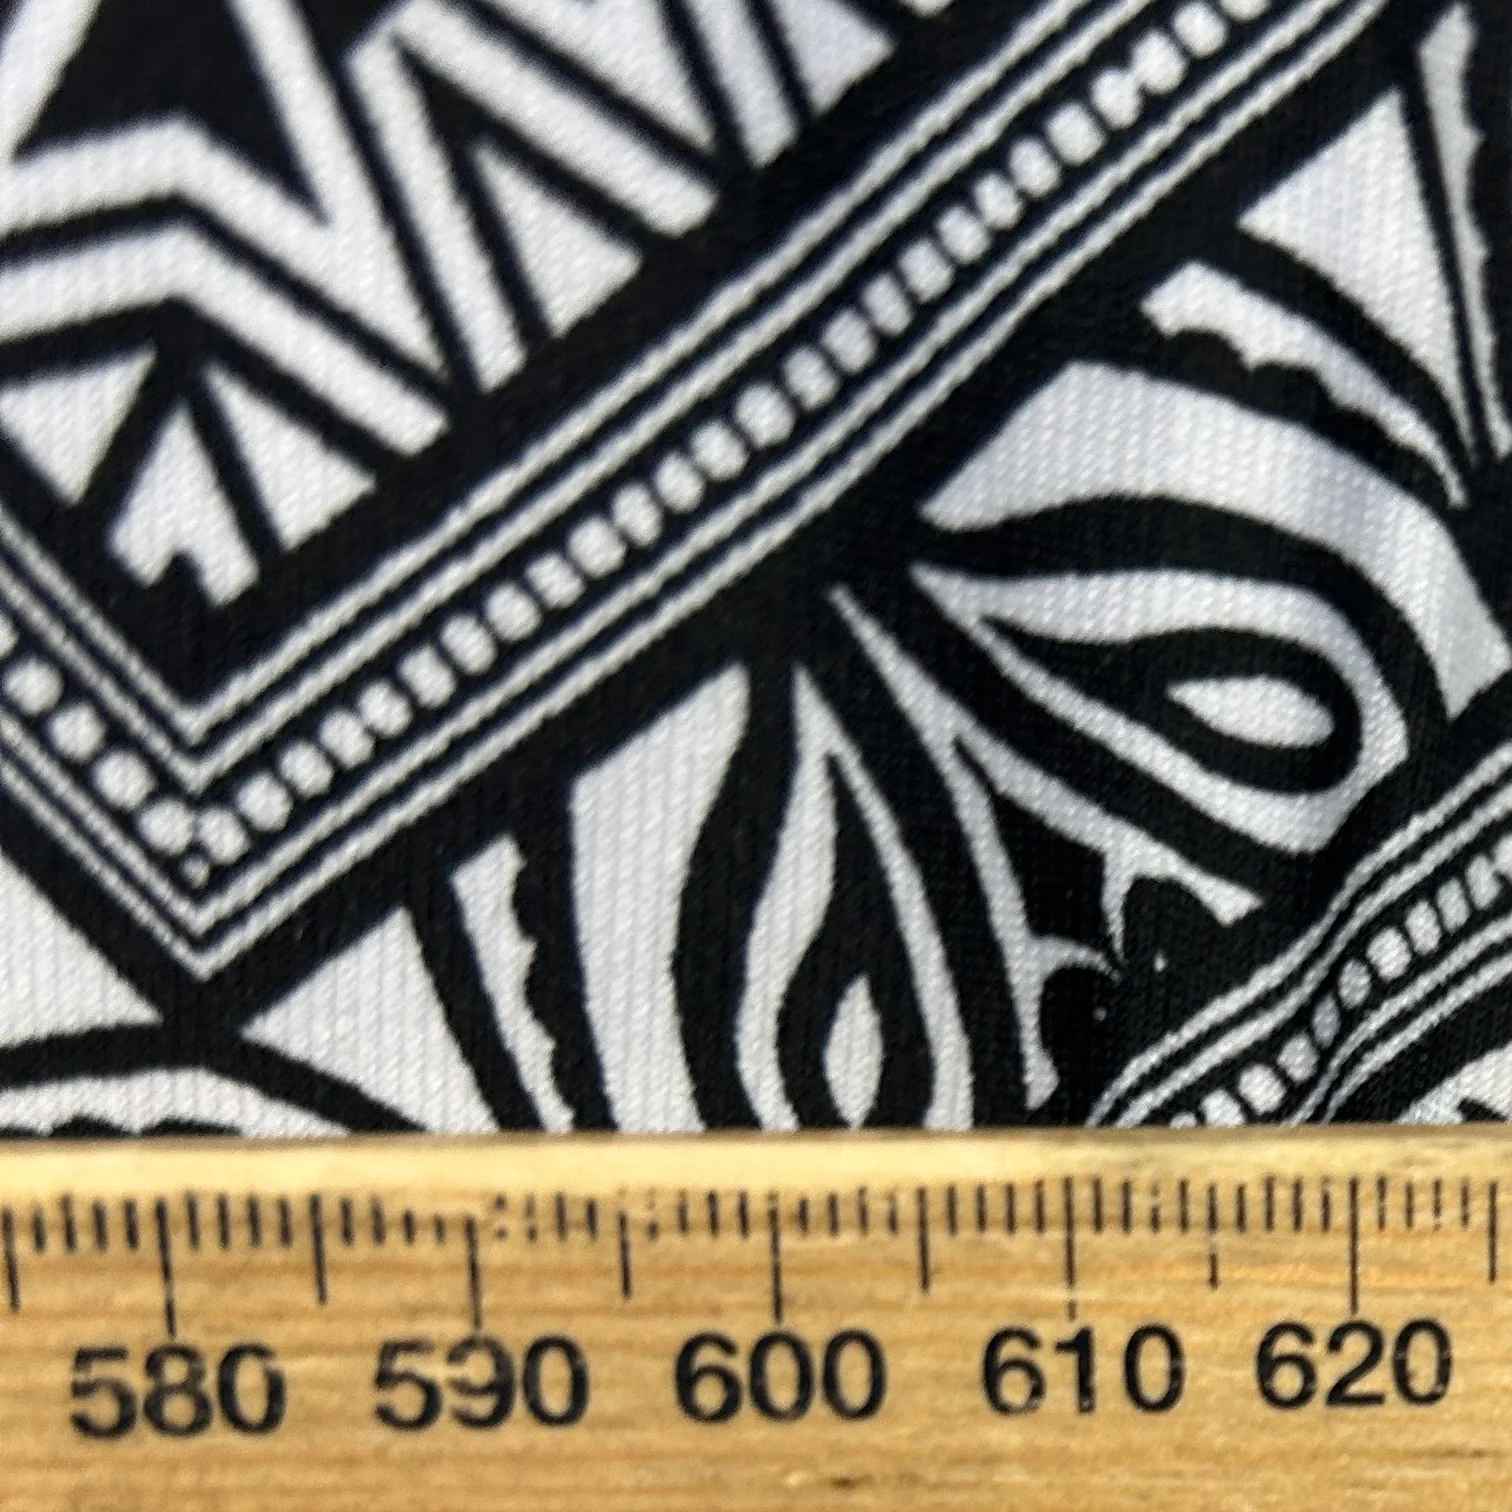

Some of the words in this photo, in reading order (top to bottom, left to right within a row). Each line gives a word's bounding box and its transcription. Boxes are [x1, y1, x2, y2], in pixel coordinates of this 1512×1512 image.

[71, 1342, 286, 1440] 580
[373, 1335, 589, 1431] 590
[674, 1330, 887, 1424] 600
[981, 1323, 1184, 1415] 610
[1255, 1318, 1453, 1409] 620
